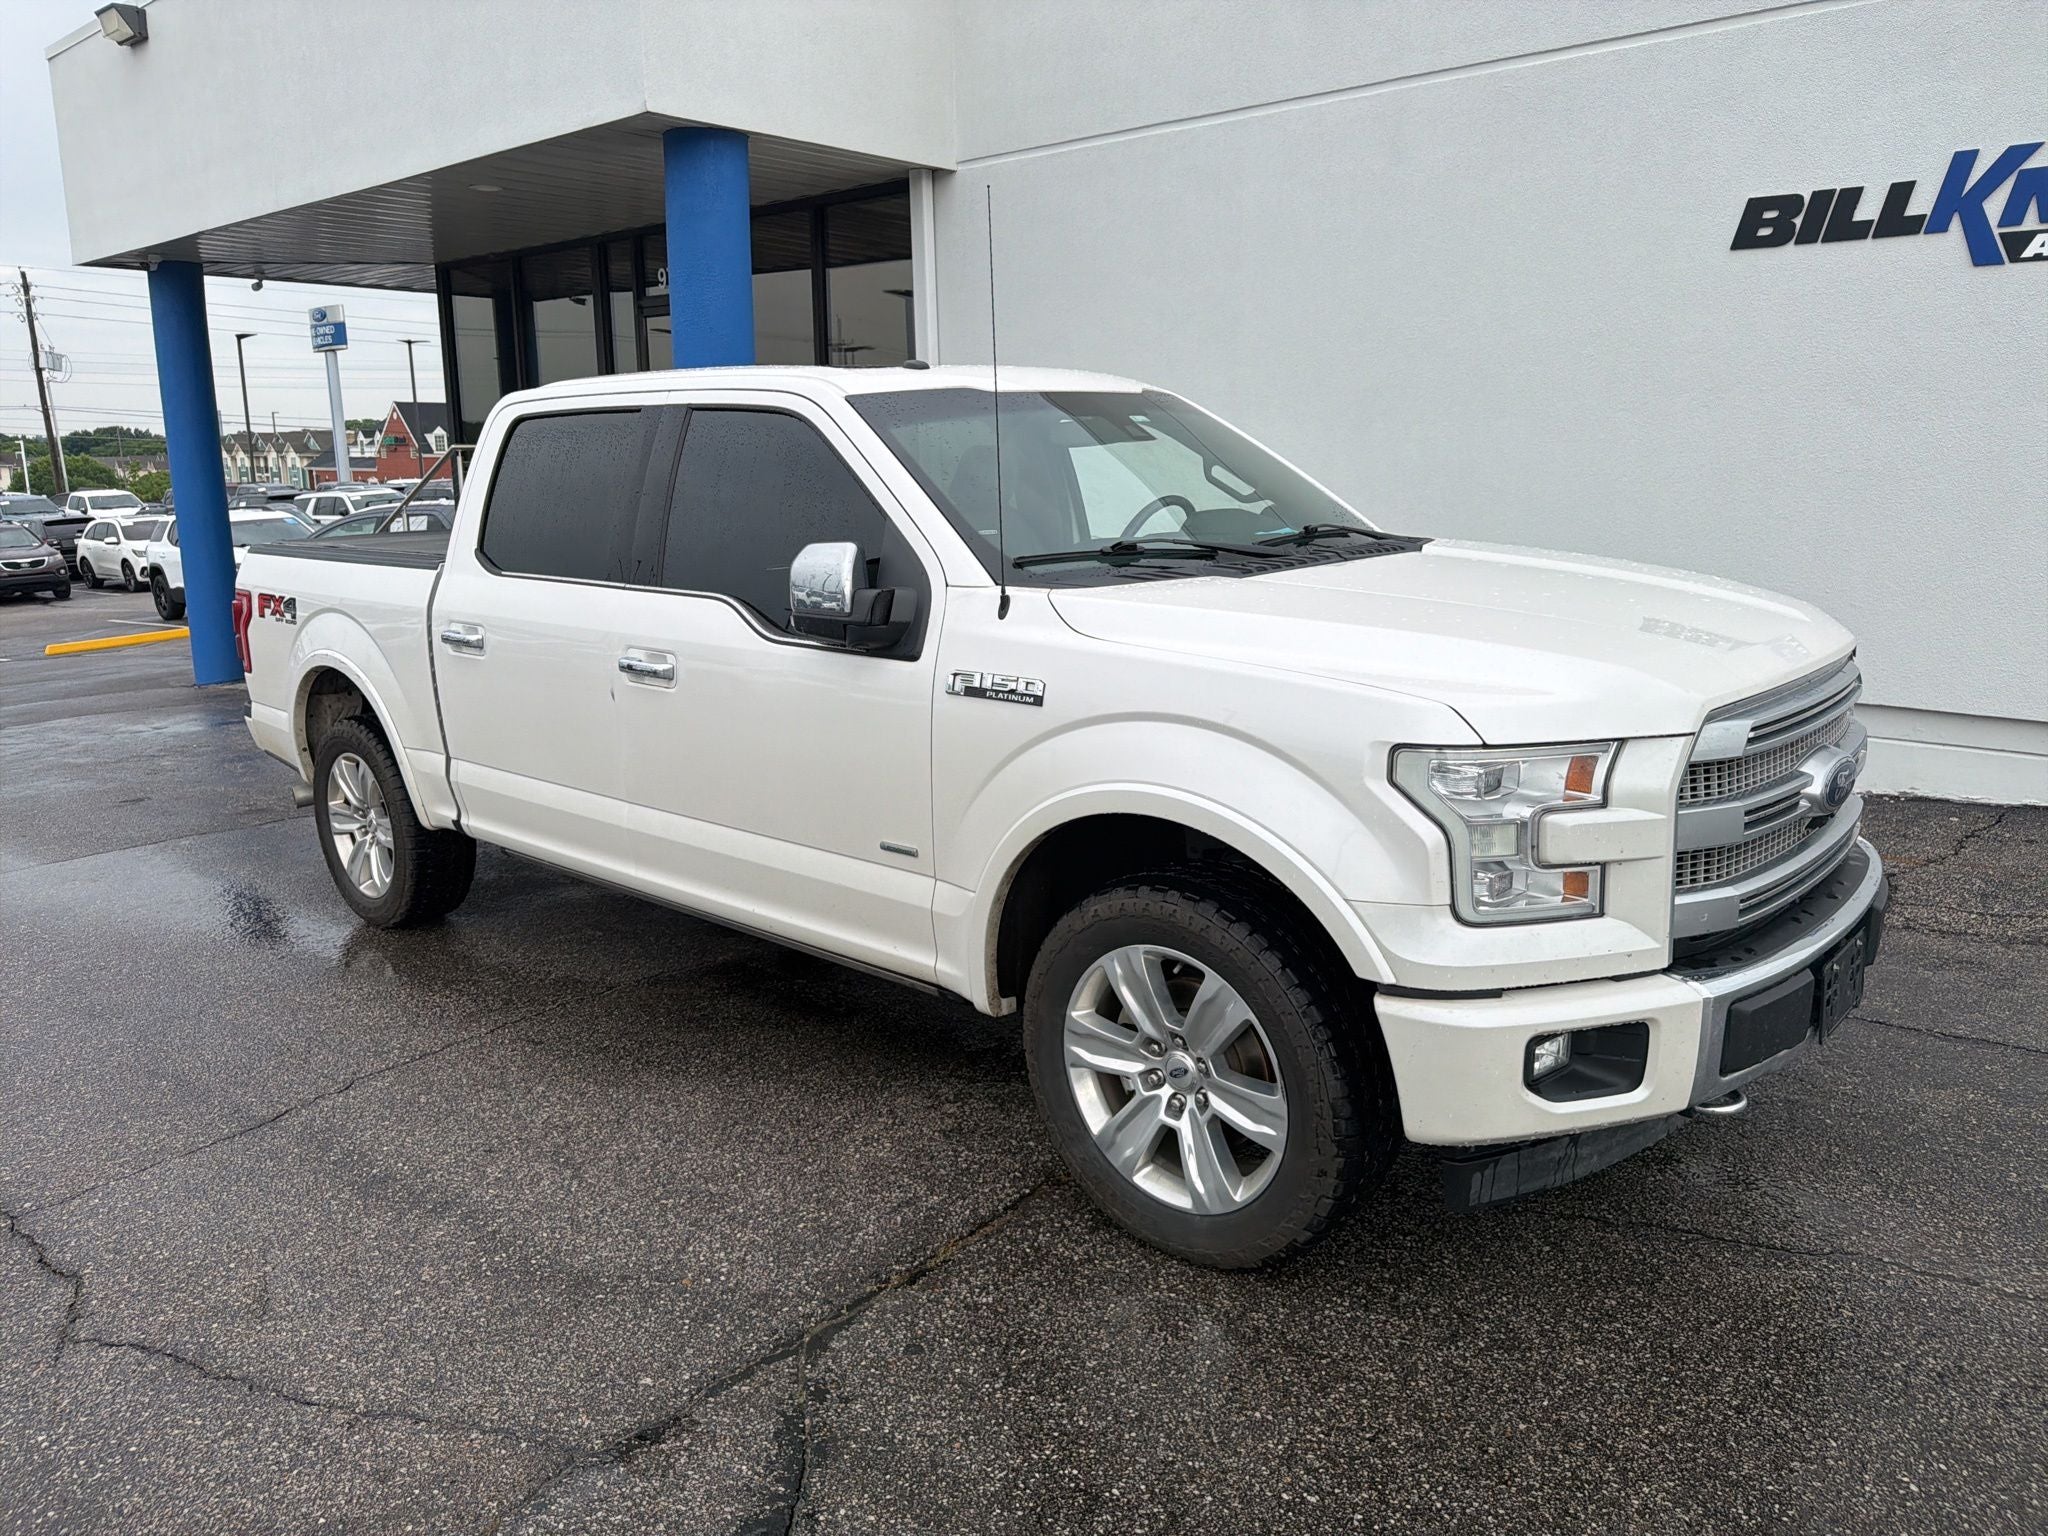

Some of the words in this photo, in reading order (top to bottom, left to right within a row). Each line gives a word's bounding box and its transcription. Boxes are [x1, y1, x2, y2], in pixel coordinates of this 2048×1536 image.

[1731, 180, 1927, 250] BILL
[258, 593, 296, 620] FX4
[986, 690, 1034, 703] PLATINUM
